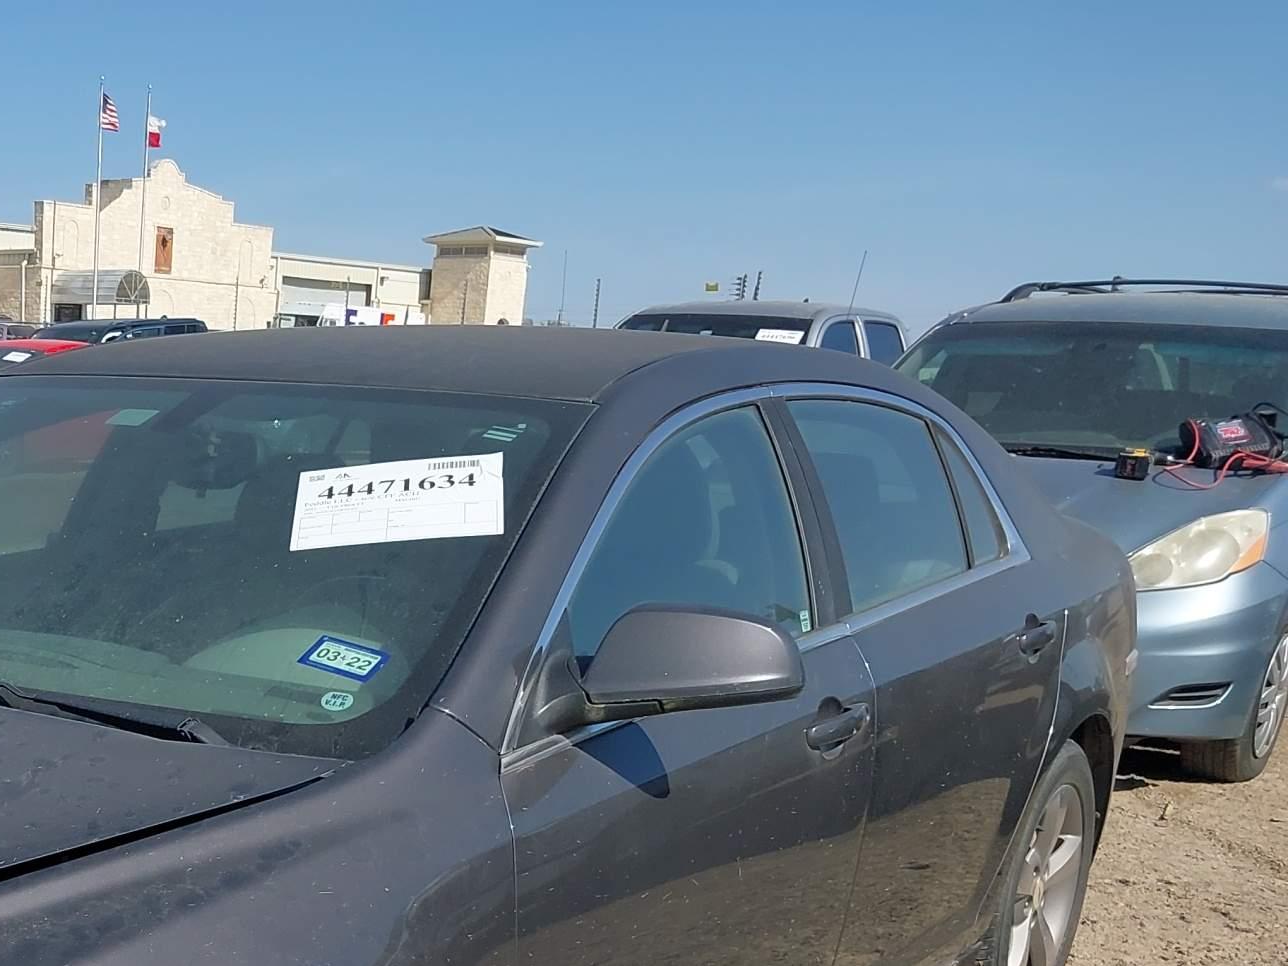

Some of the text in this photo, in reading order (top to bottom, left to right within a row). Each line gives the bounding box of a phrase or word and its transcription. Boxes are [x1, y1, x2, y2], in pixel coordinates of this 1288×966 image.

[318, 473, 476, 499] 44471634
[316, 648, 341, 662] 03
[345, 656, 373, 671] 22
